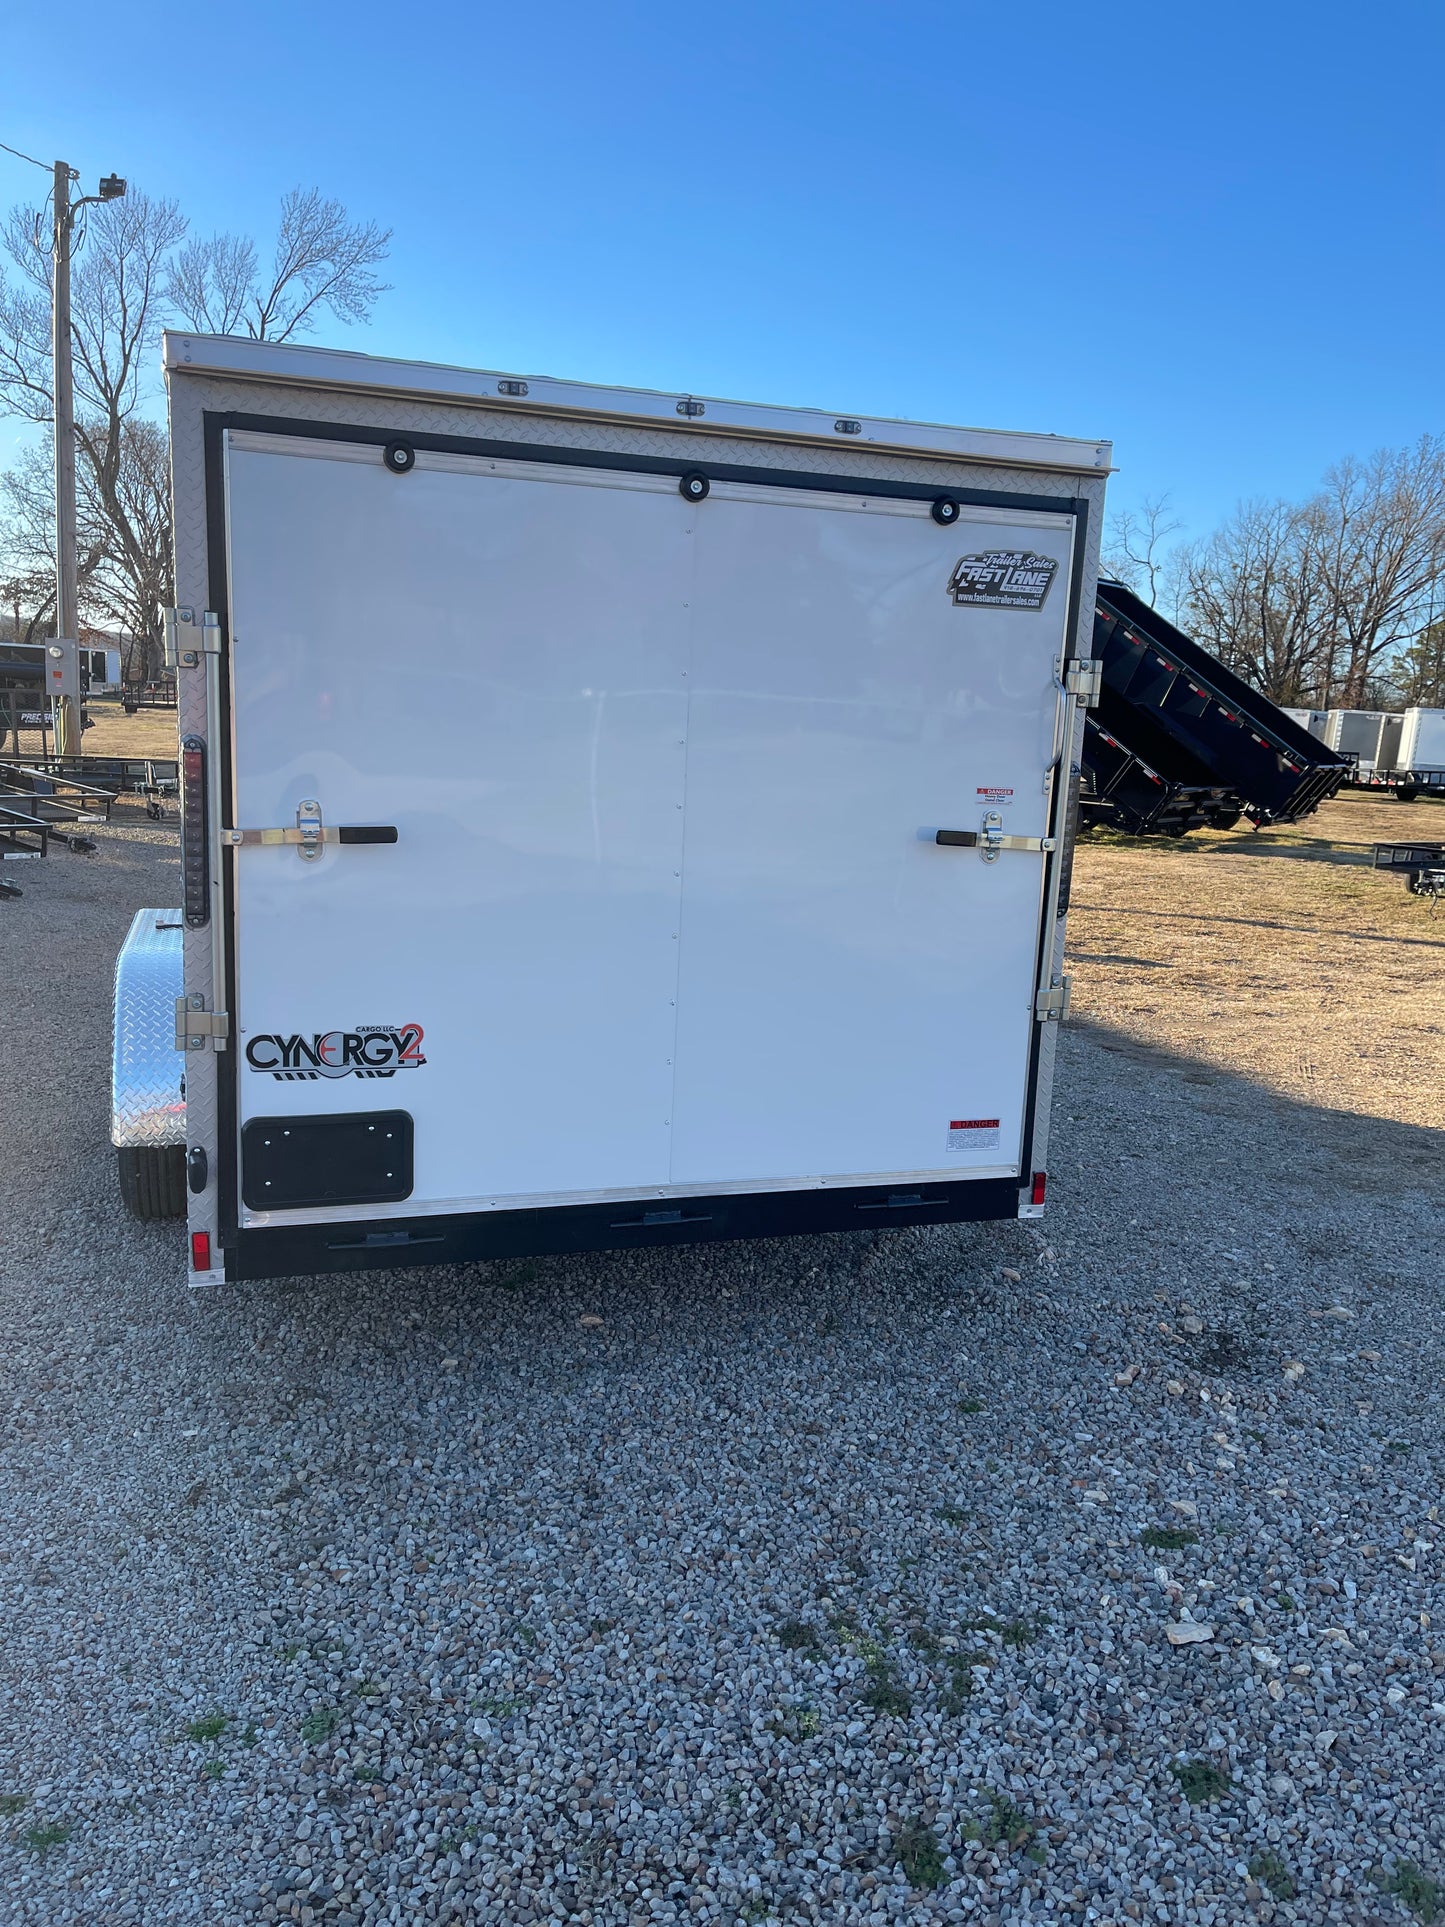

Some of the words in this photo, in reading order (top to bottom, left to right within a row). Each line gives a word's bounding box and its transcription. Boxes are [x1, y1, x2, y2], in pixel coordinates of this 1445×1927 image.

[985, 553, 1022, 568] Trailer
[1024, 557, 1056, 570] Sales
[955, 561, 1006, 583] FAST
[1000, 567, 1050, 590] LANE
[957, 592, 1040, 607] www.fastlanetrailersales.com
[960, 1120, 999, 1128] DANGER
